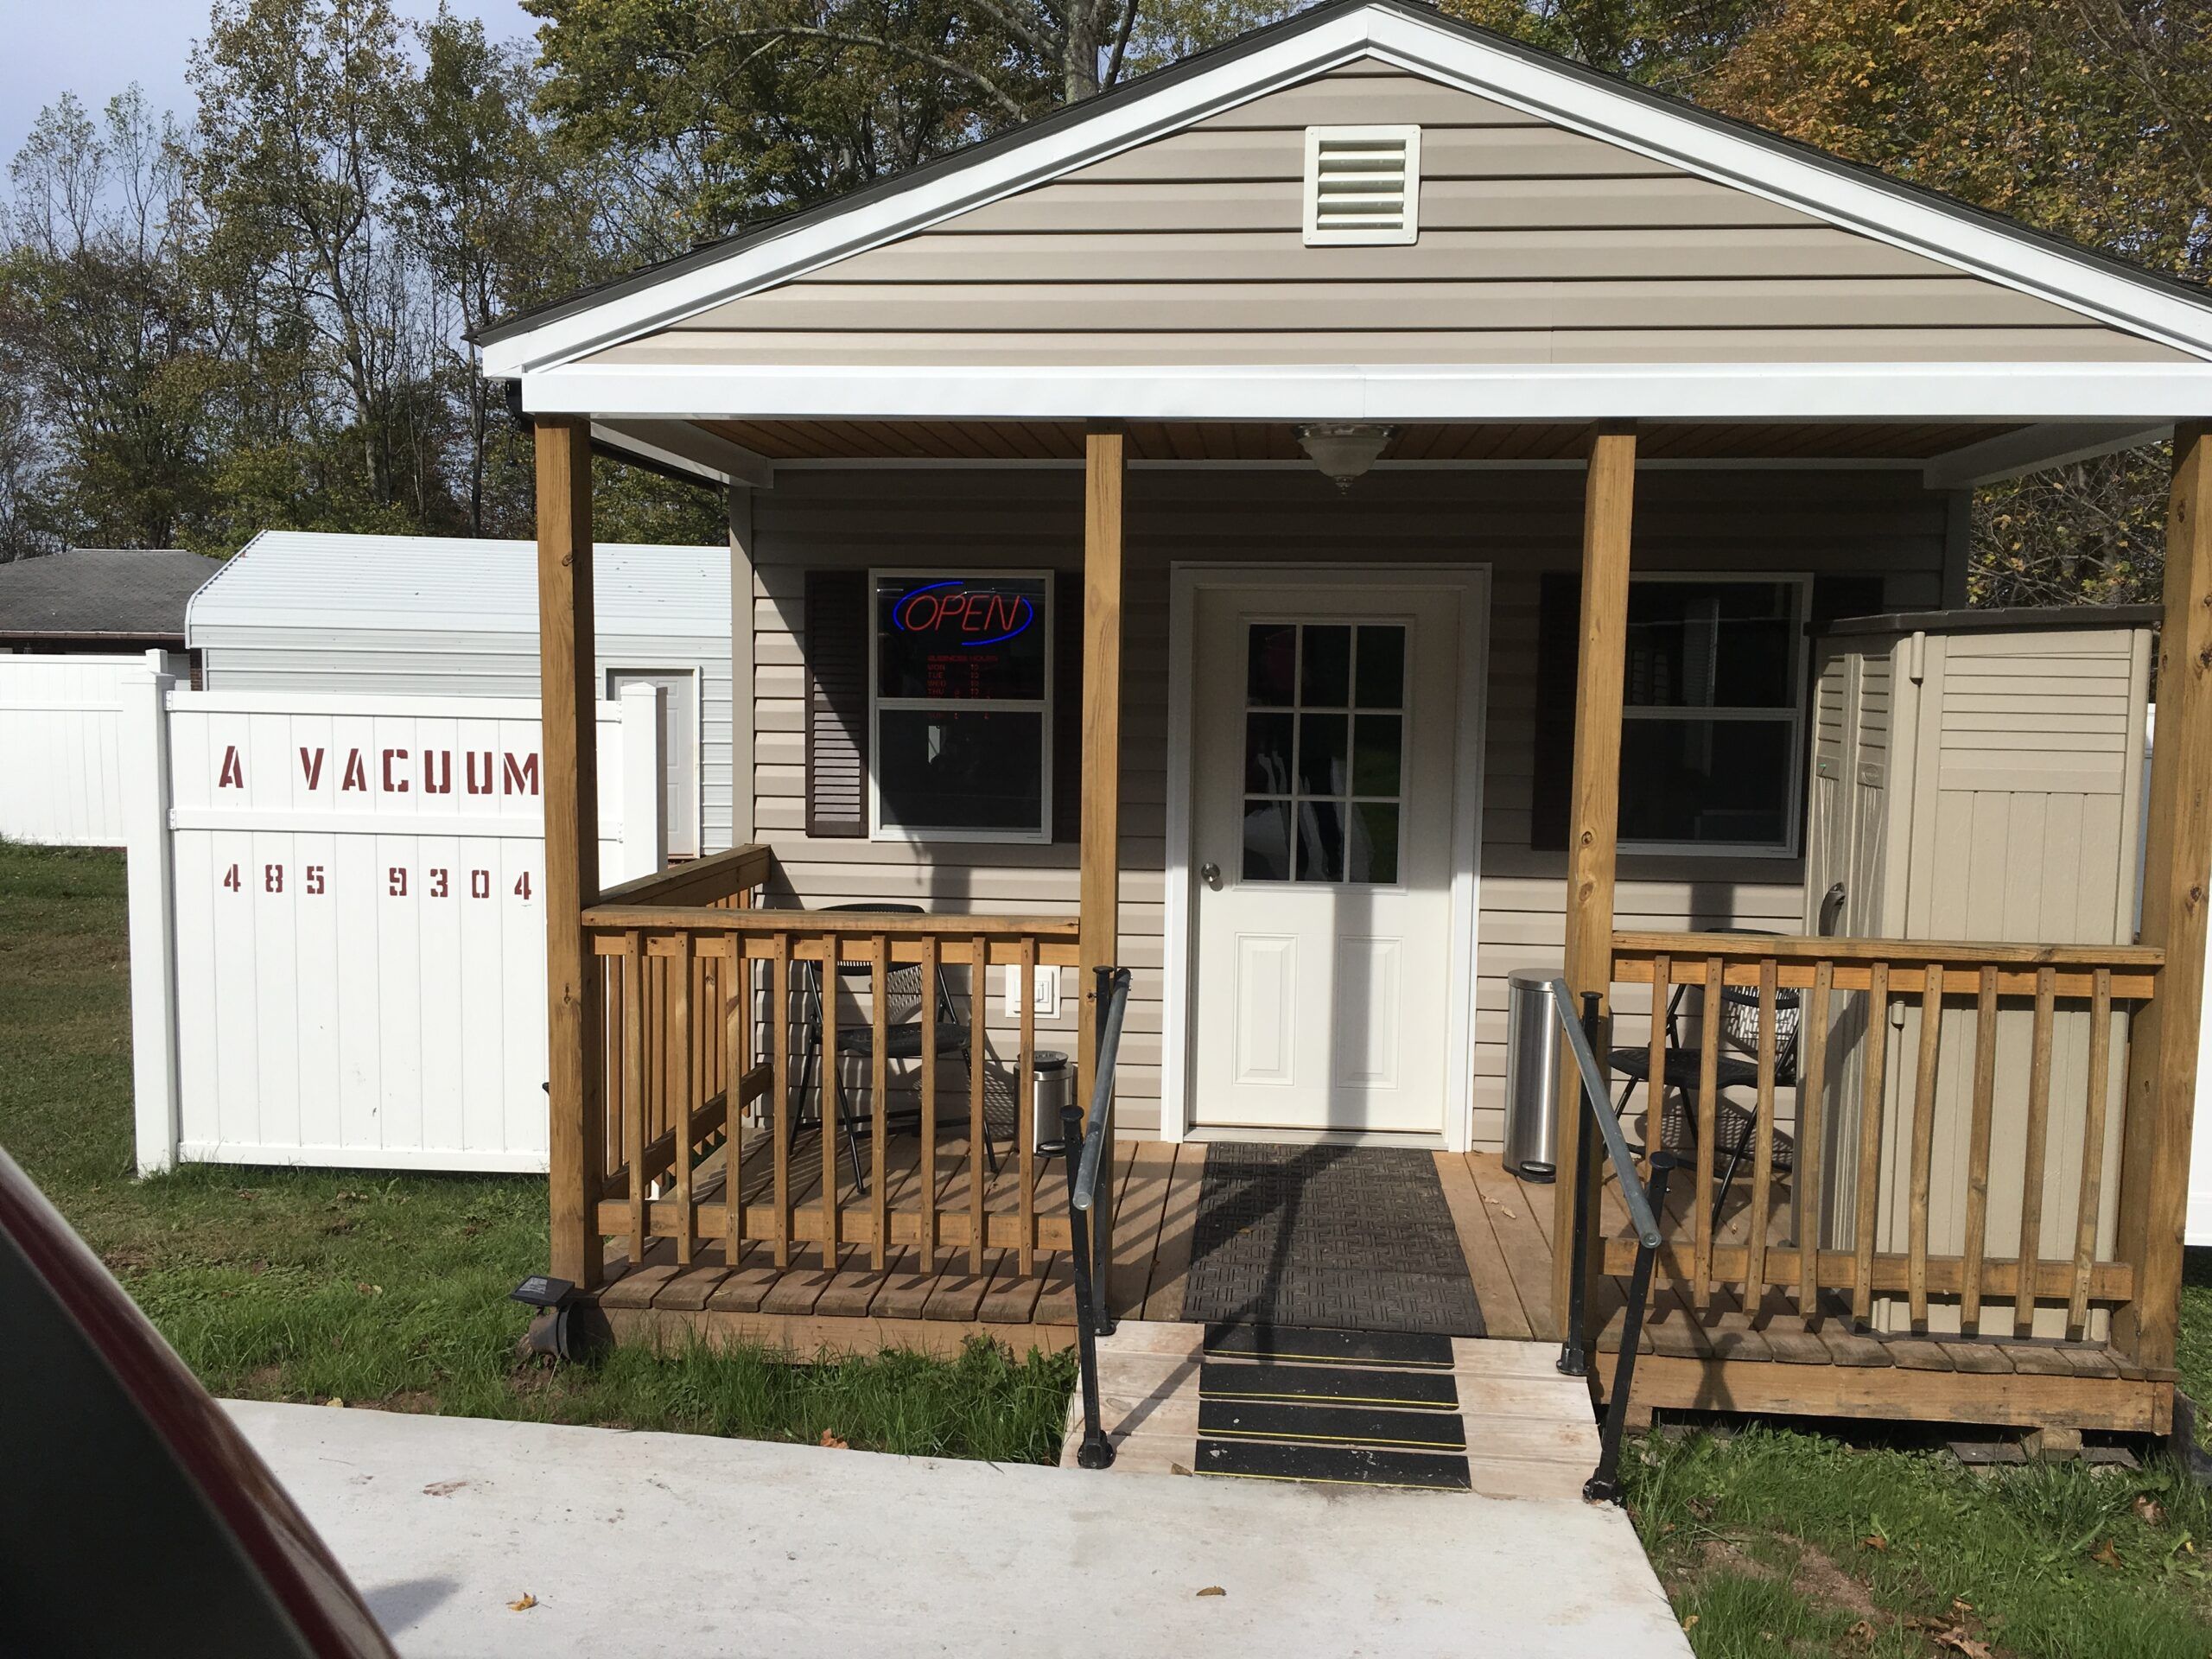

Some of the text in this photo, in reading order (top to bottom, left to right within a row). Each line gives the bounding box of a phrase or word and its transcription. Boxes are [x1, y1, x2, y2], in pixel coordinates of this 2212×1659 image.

[906, 594, 1020, 631] OPEN
[219, 746, 539, 795] A VACUUM
[224, 864, 532, 899] 485 9304
